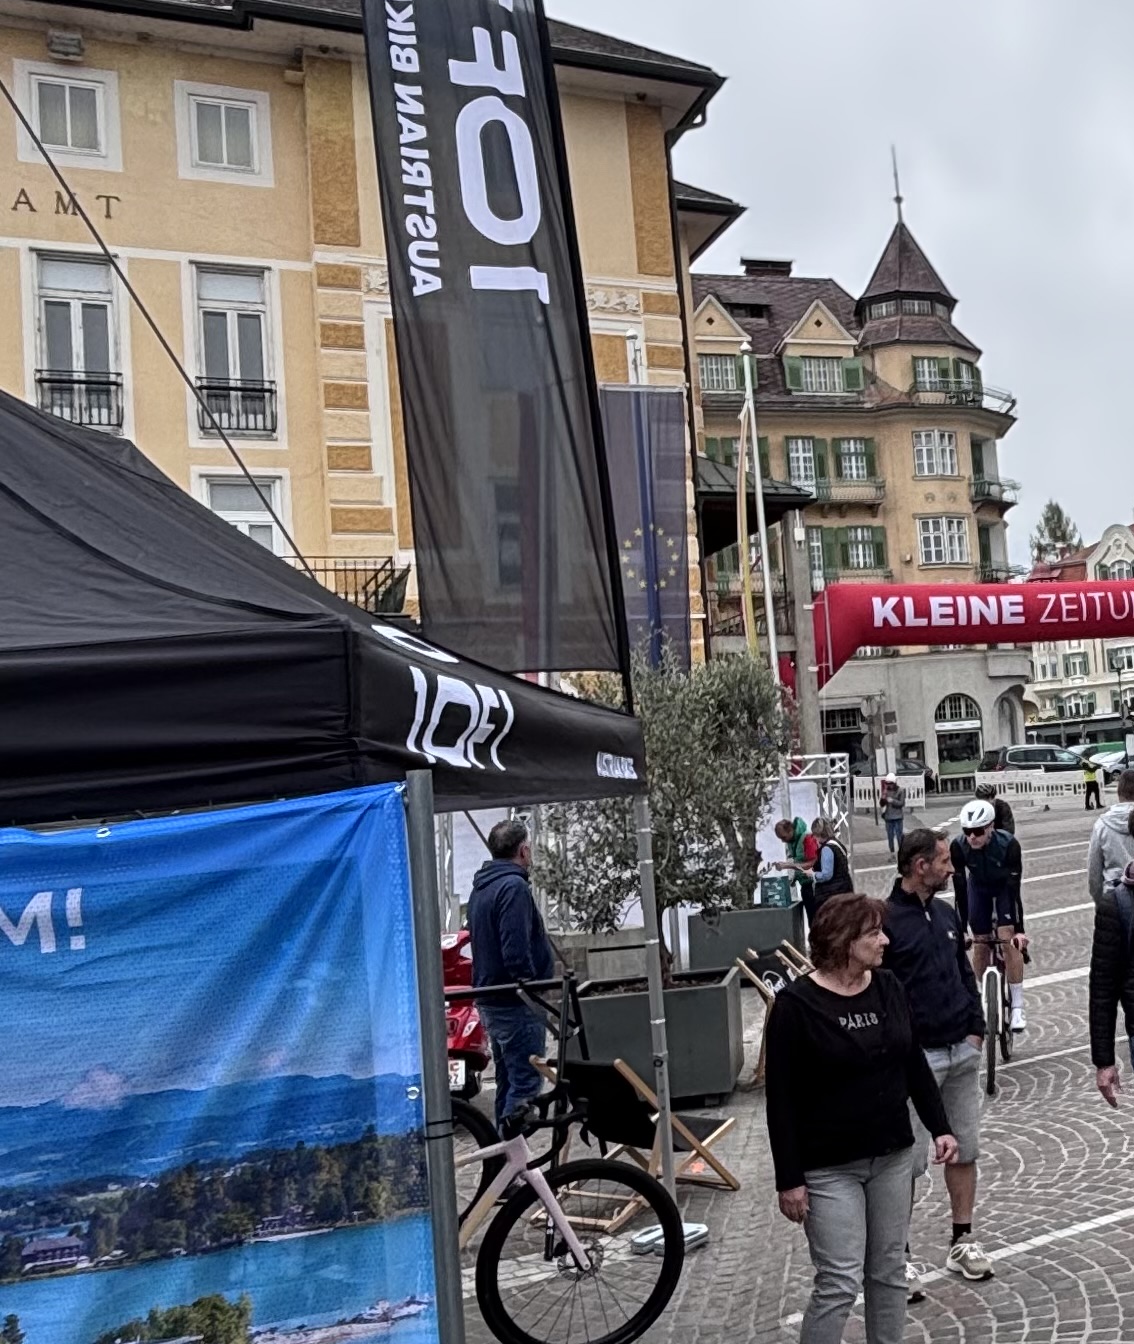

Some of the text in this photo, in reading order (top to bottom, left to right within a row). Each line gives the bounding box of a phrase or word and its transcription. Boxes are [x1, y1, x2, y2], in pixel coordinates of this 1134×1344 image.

[11, 187, 122, 219] AMT
[872, 595, 1026, 628] KLEINE
[839, 1012, 879, 1030] PARIS
